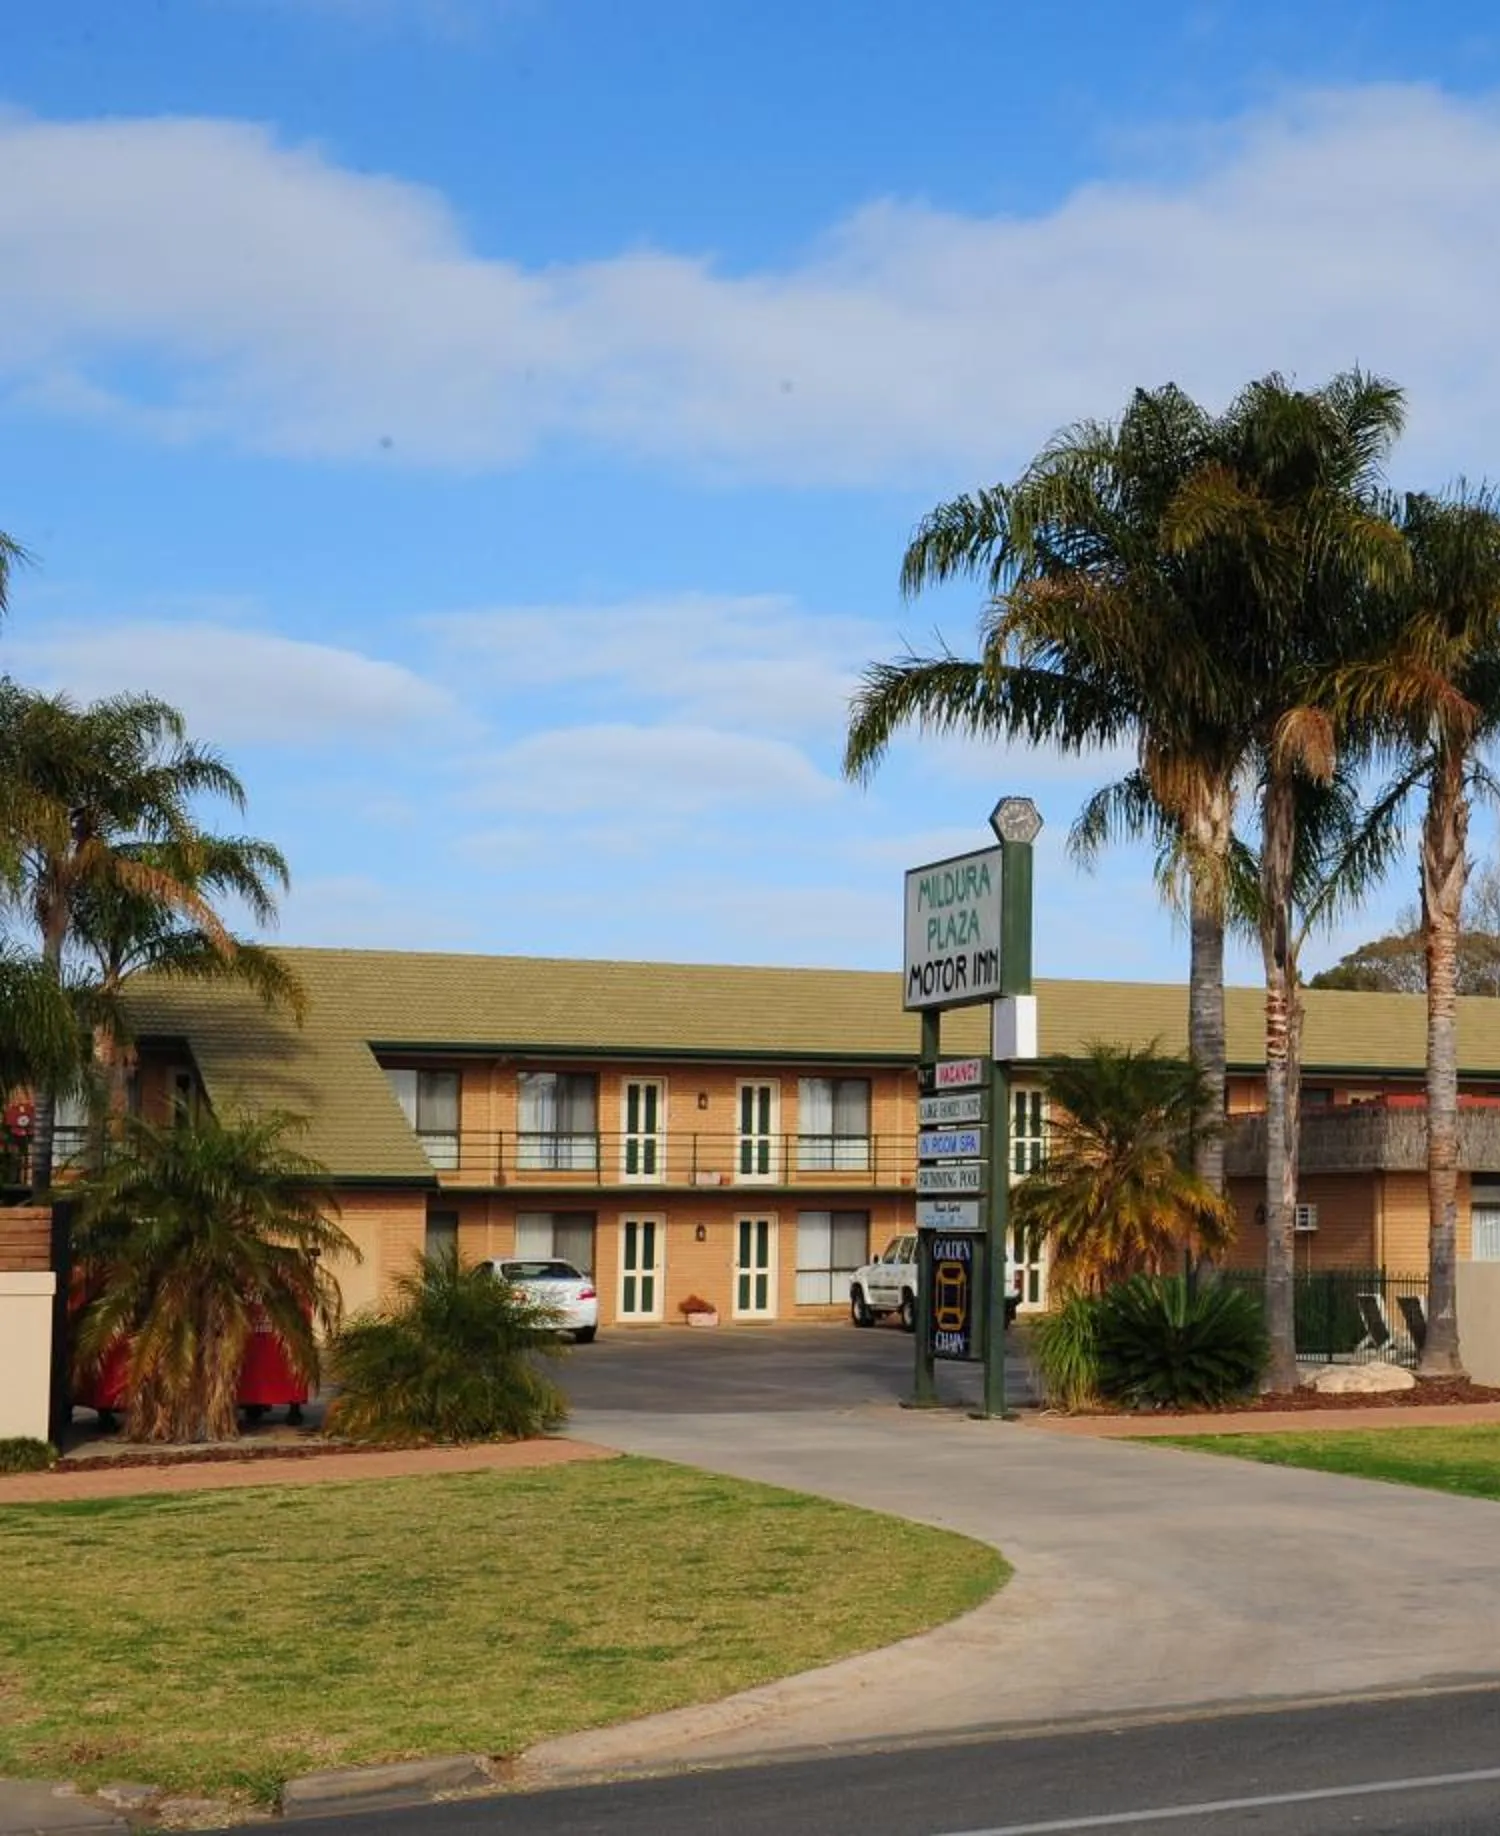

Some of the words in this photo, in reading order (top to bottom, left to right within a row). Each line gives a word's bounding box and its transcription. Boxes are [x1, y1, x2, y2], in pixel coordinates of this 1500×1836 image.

[917, 864, 991, 913] MILDURA
[927, 908, 981, 952] PLAZA
[908, 954, 967, 999] MOTOR
[973, 947, 999, 987] INN
[938, 1062, 978, 1084] VACANCY
[932, 1135, 957, 1153] ROOM
[960, 1135, 977, 1152] SPA
[960, 1169, 978, 1188] POOL
[933, 1239, 971, 1261] GOLDEN
[934, 1332, 966, 1353] CHAIN
